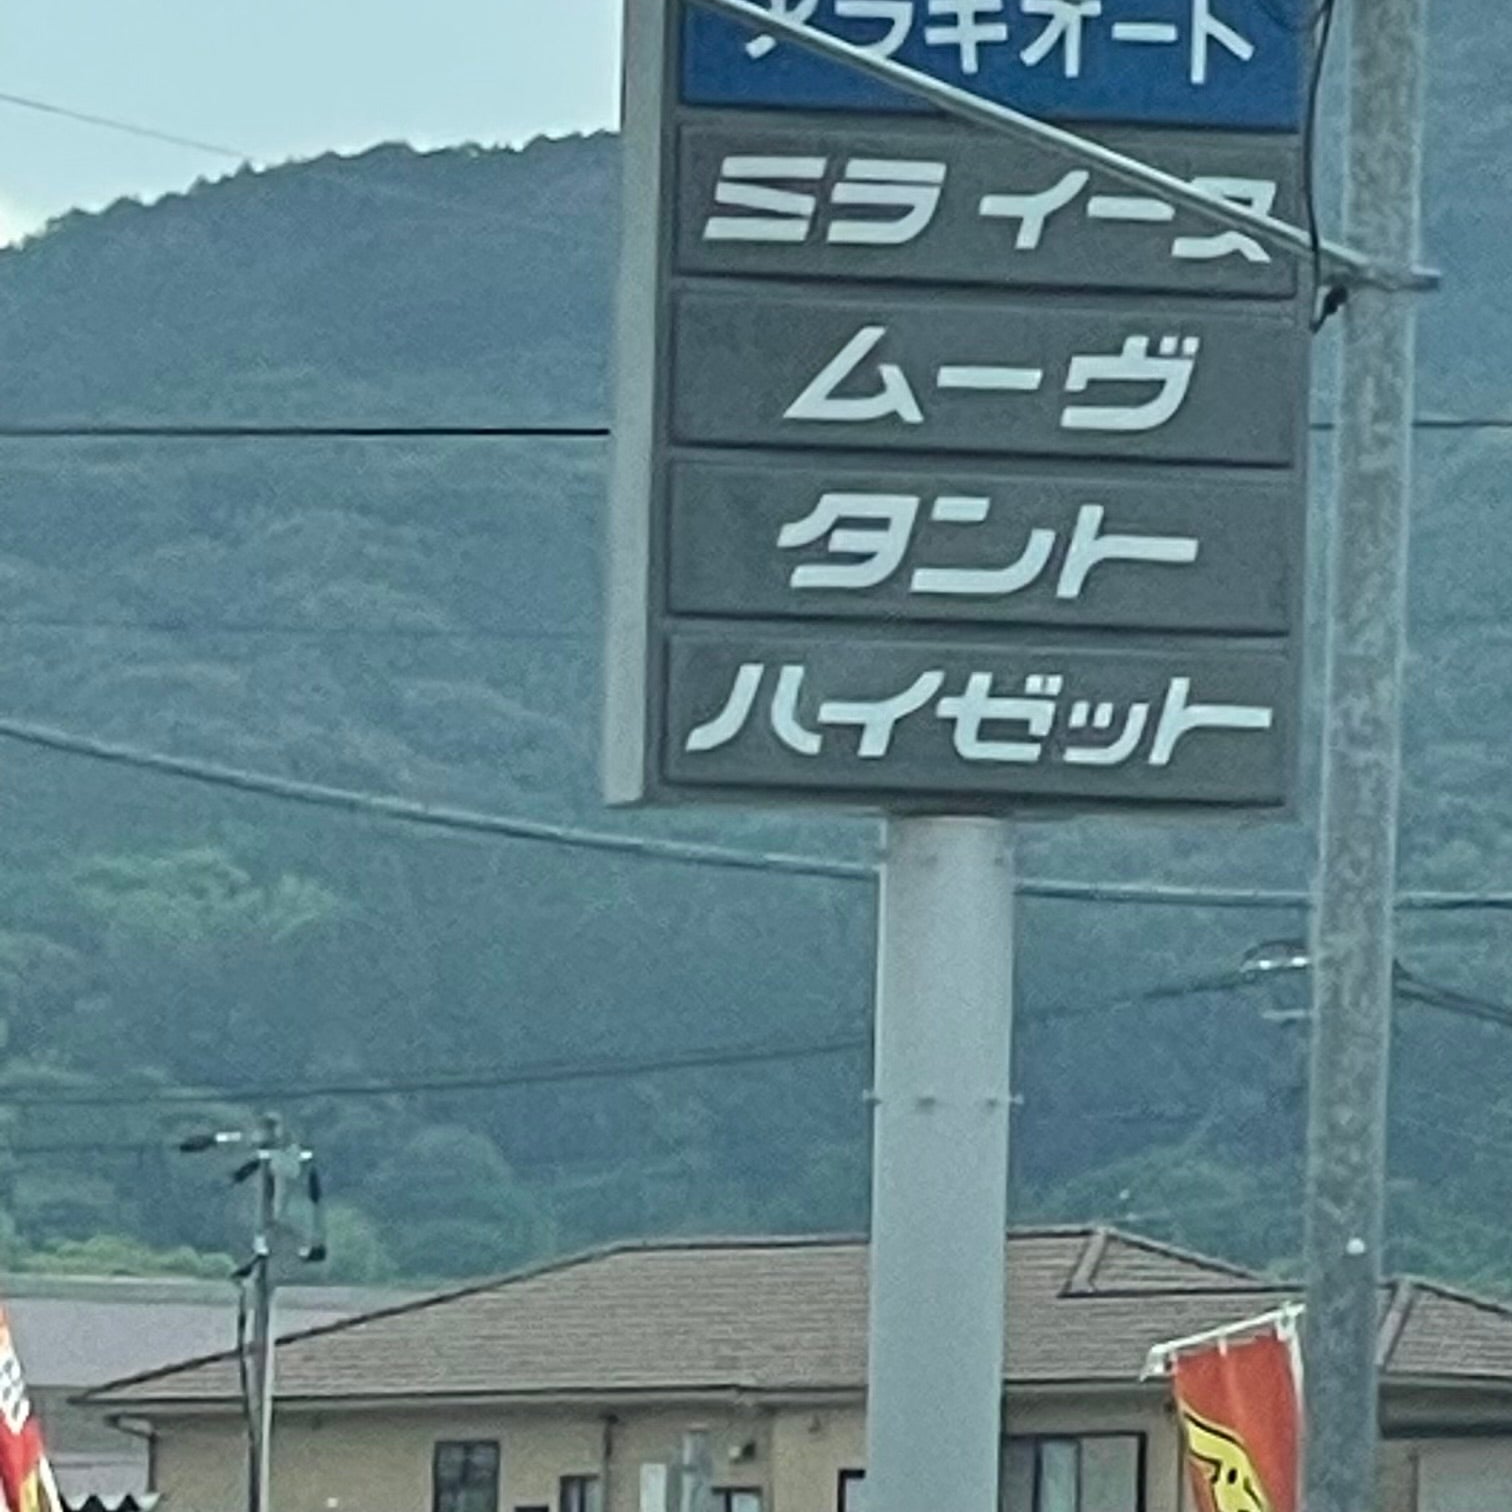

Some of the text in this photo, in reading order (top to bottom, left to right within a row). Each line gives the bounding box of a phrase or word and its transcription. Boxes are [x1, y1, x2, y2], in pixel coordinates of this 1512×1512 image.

[783, 326, 1198, 432] ムーヴ
[776, 492, 1198, 599] タント
[684, 662, 1273, 768] ハイゼット
